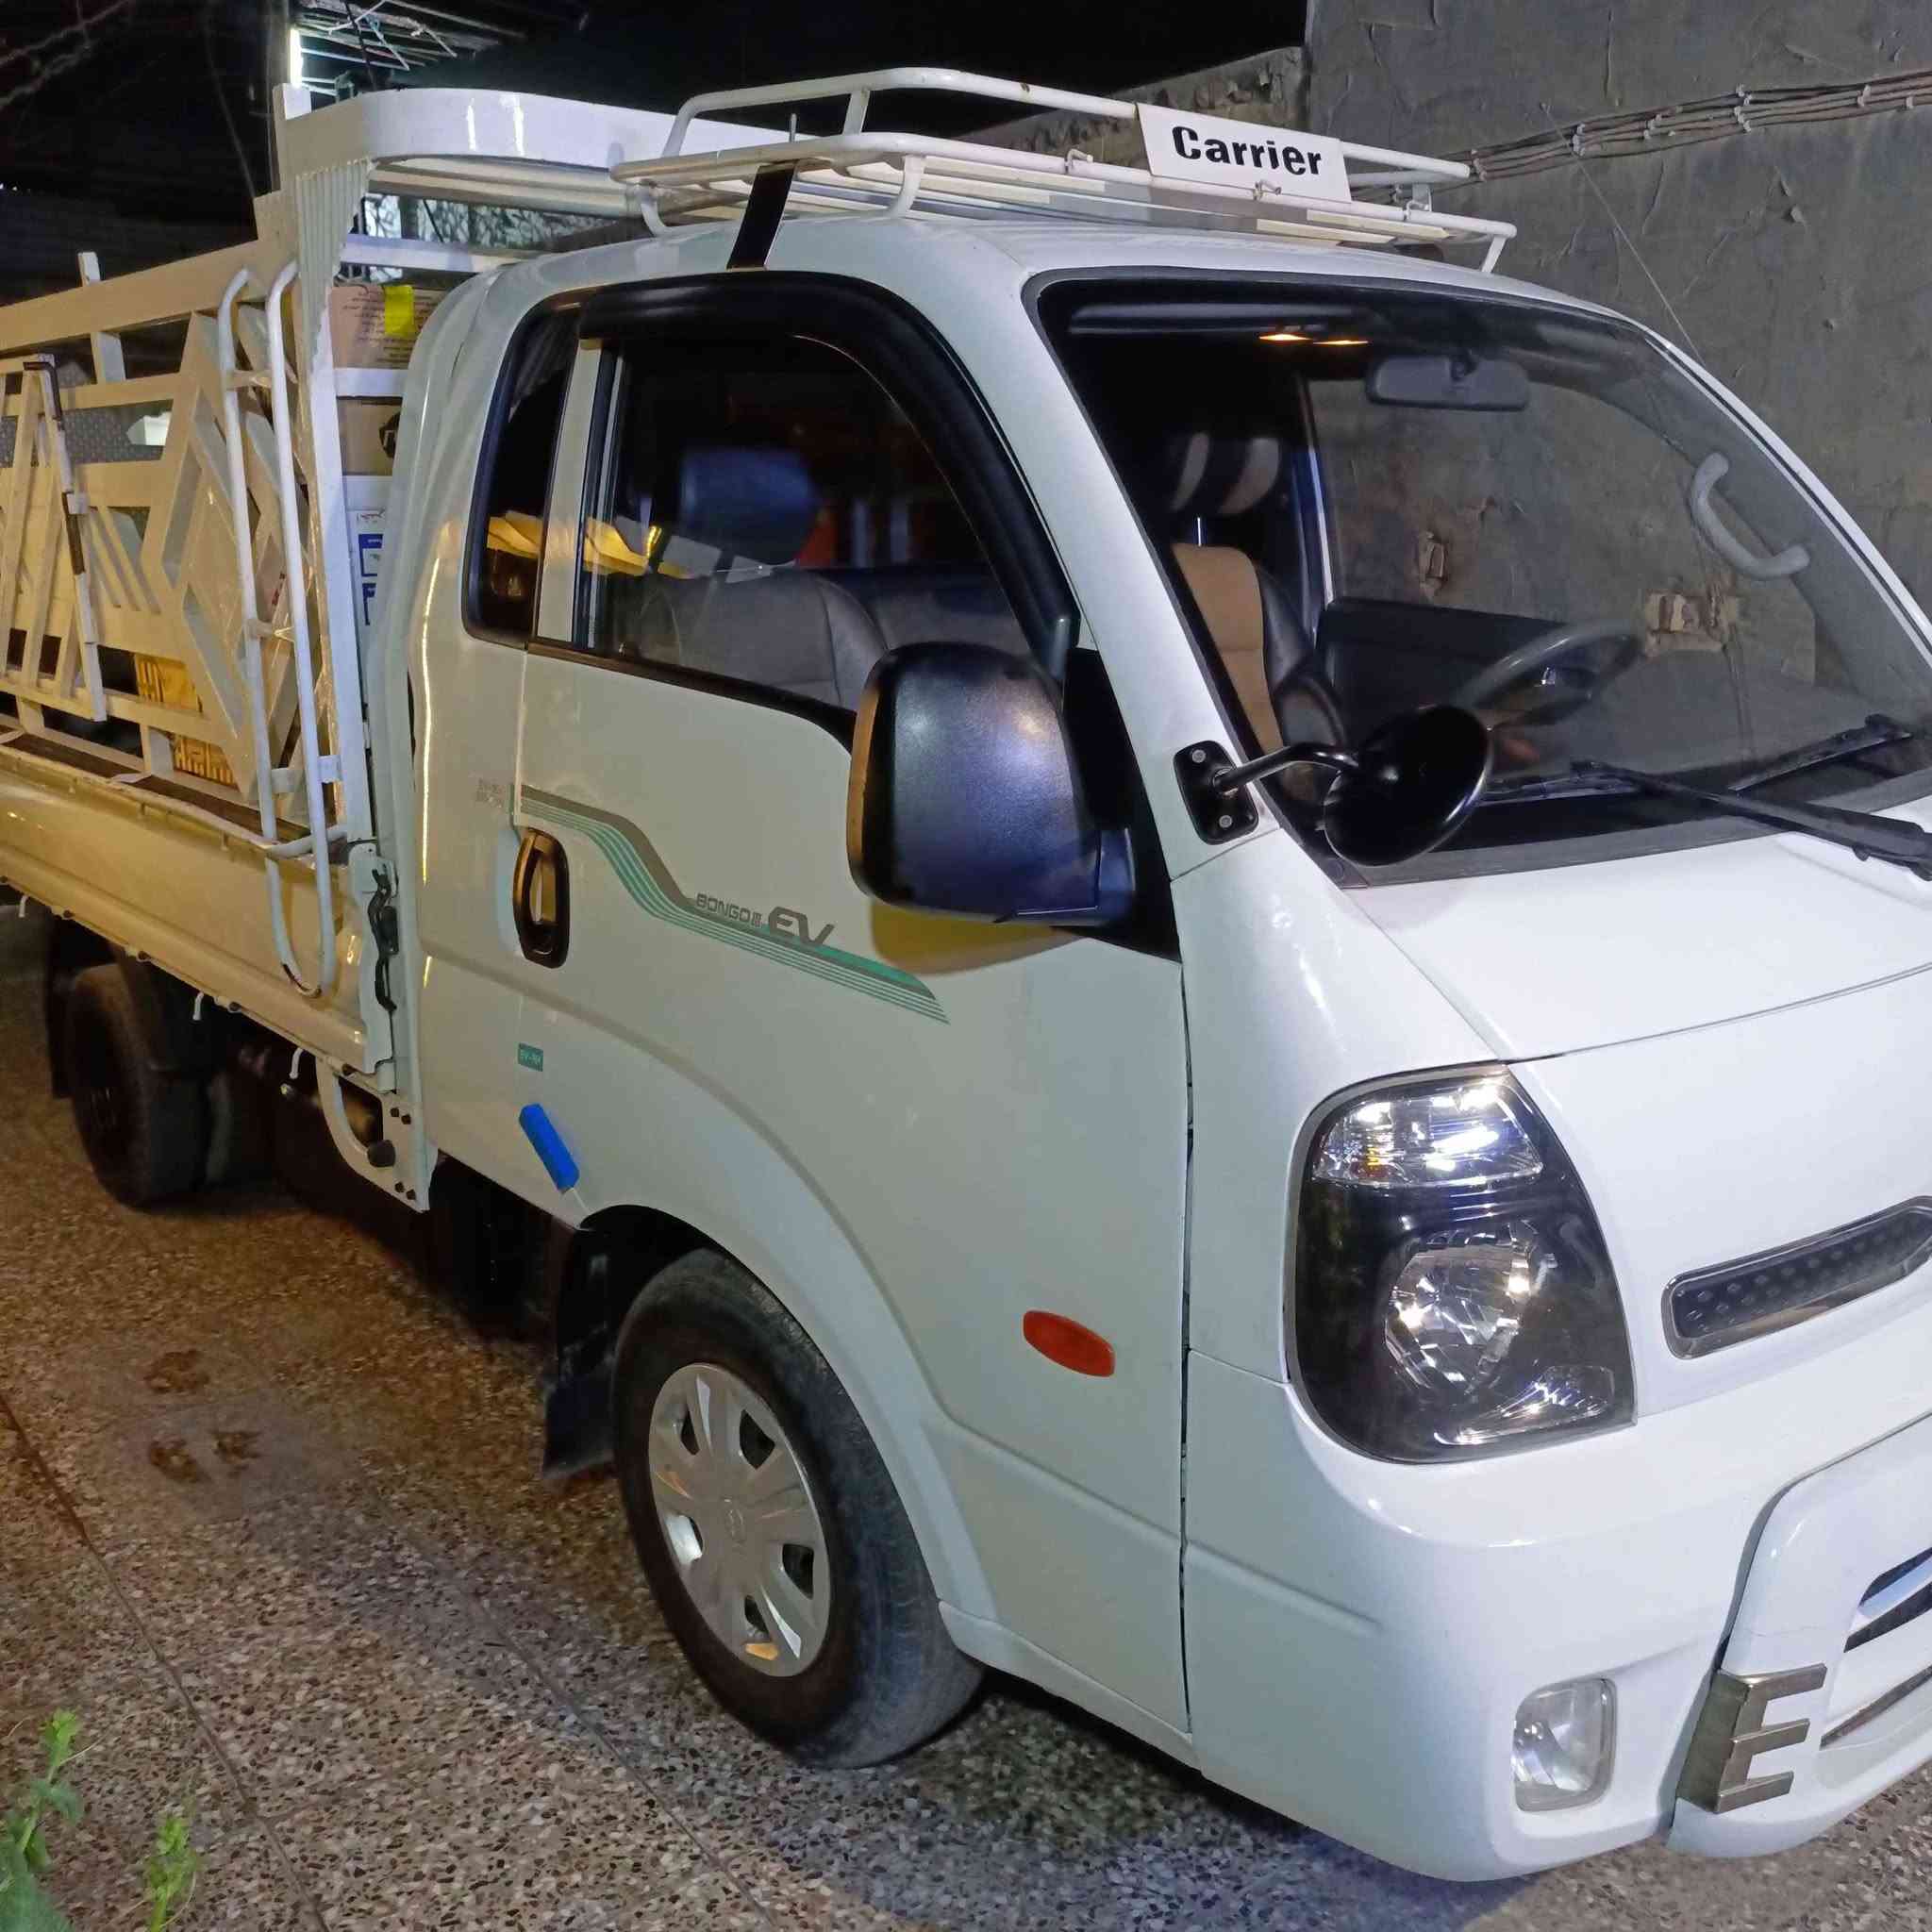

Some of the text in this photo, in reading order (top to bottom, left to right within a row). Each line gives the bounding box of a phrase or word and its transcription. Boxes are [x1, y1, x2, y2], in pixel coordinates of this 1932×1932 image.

[1172, 125, 1322, 175] Carrier
[696, 892, 751, 923] BONGO
[768, 906, 836, 946] EV
